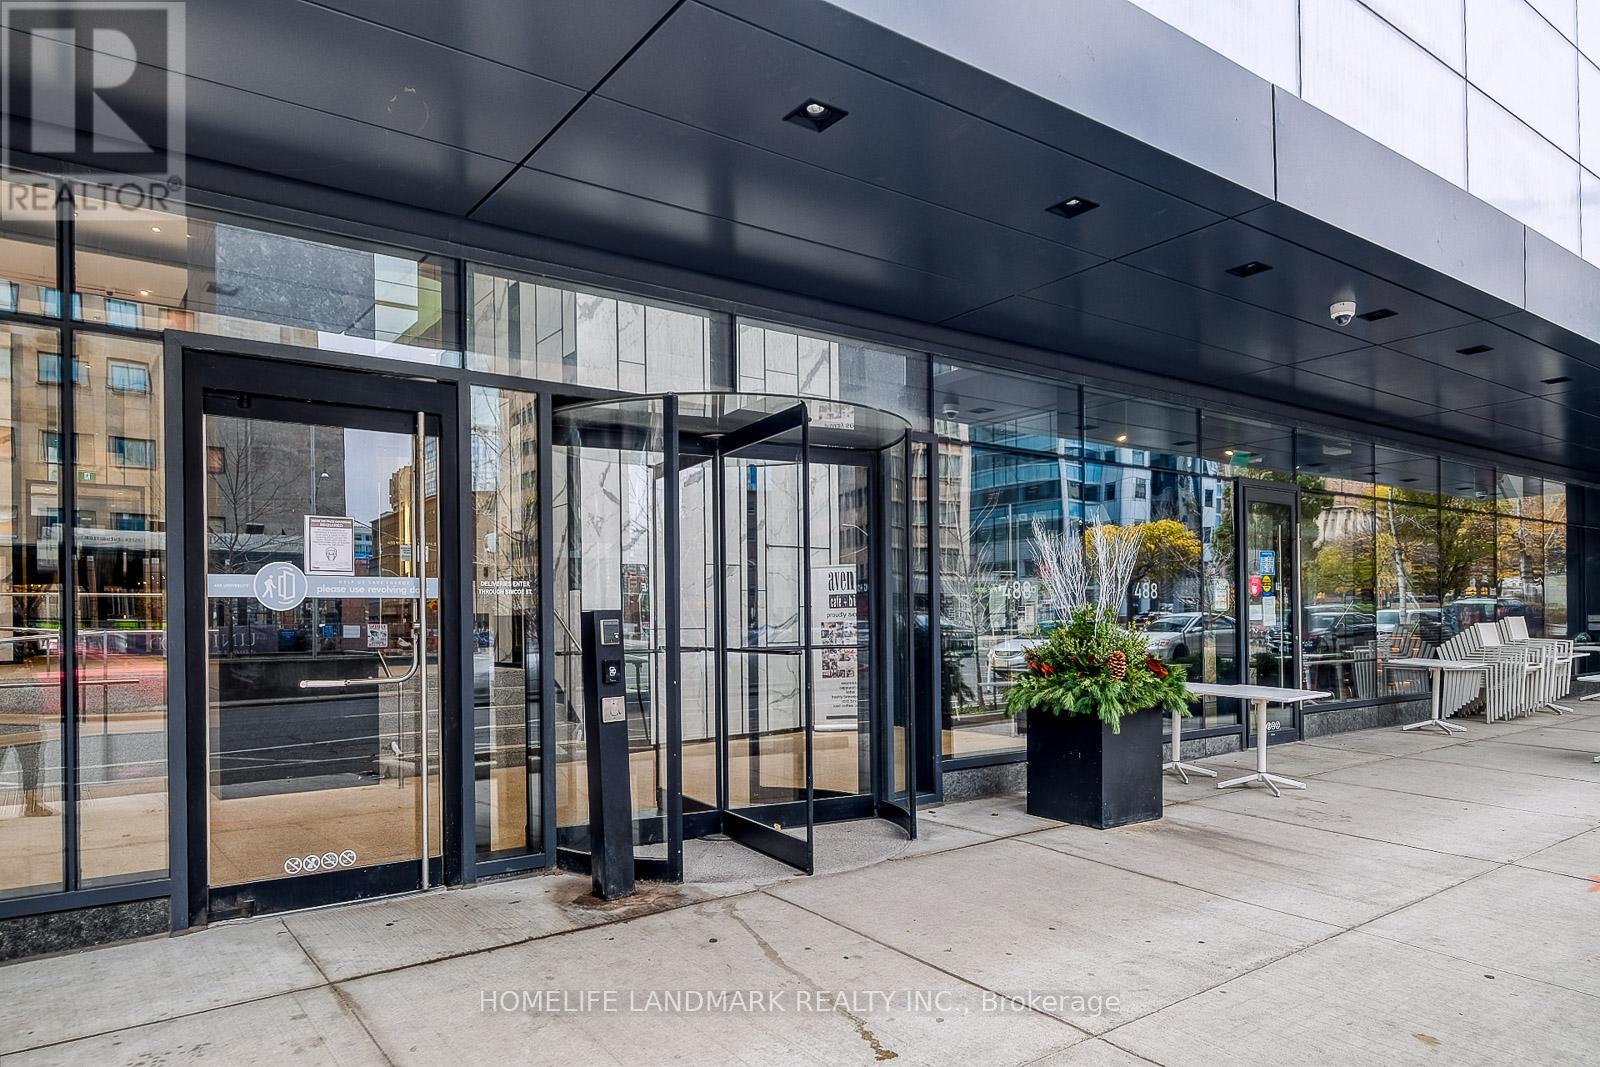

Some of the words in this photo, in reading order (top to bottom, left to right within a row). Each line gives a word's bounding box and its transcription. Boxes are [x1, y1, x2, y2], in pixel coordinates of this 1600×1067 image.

[316, 583, 347, 595] please
[367, 585, 407, 595] revolving
[512, 580, 531, 588] ENTER
[1135, 582, 1158, 599] 488
